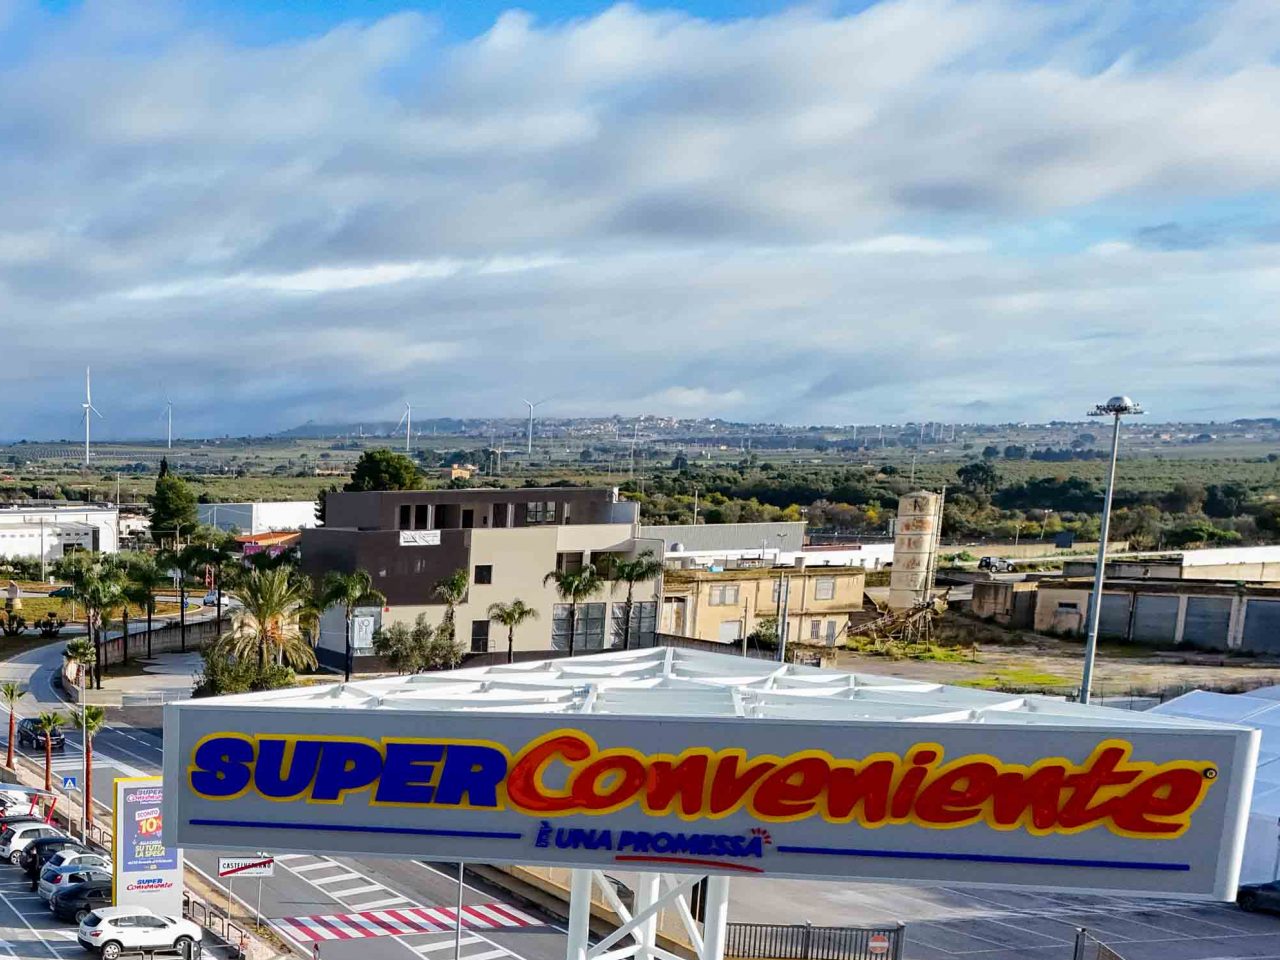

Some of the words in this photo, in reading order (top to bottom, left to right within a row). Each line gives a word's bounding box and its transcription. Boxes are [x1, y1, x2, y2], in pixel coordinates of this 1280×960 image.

[535, 821, 552, 848] È
[555, 828, 612, 850] UNA
[618, 831, 763, 858] PROMESSA
